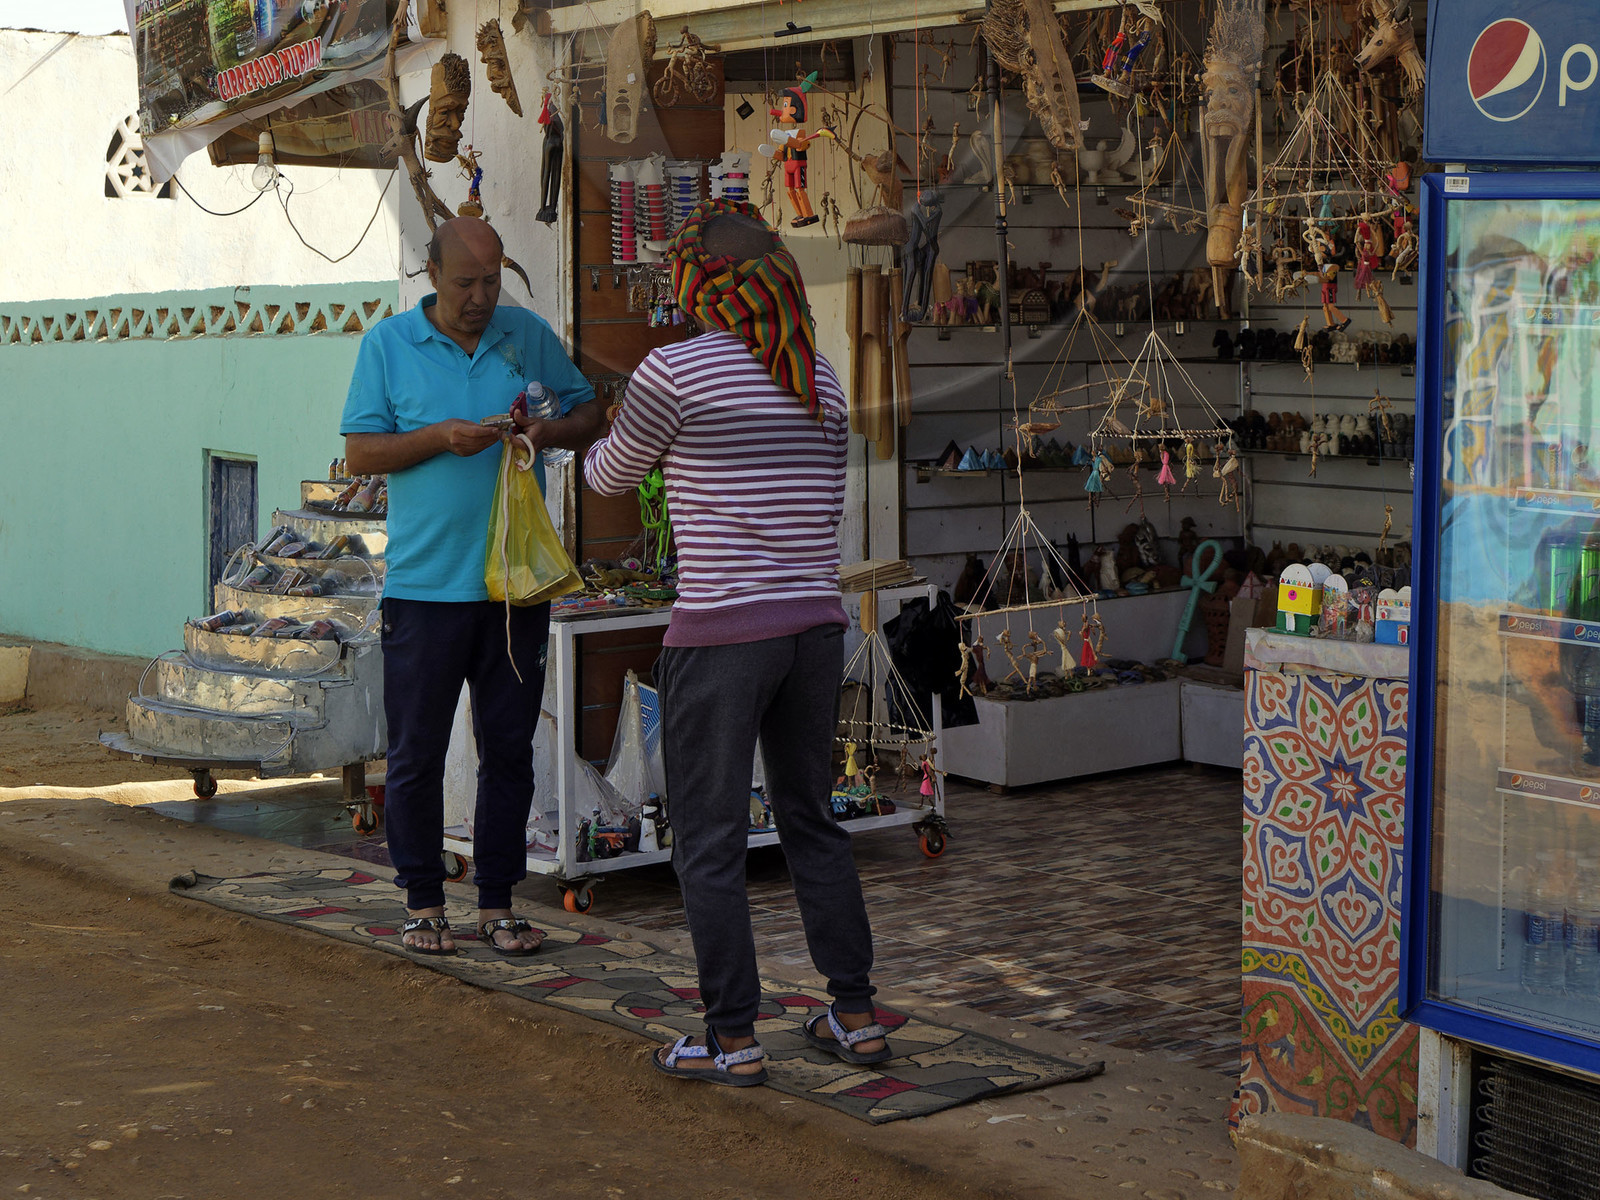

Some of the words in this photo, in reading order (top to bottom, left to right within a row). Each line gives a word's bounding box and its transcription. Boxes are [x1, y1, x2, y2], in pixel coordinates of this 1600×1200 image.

[217, 52, 283, 102] CARREFOUR
[277, 36, 322, 80] NUBIAN
[1535, 496, 1560, 505] pepsi
[1518, 621, 1542, 631] pepsi
[1522, 779, 1547, 790] pepsi
